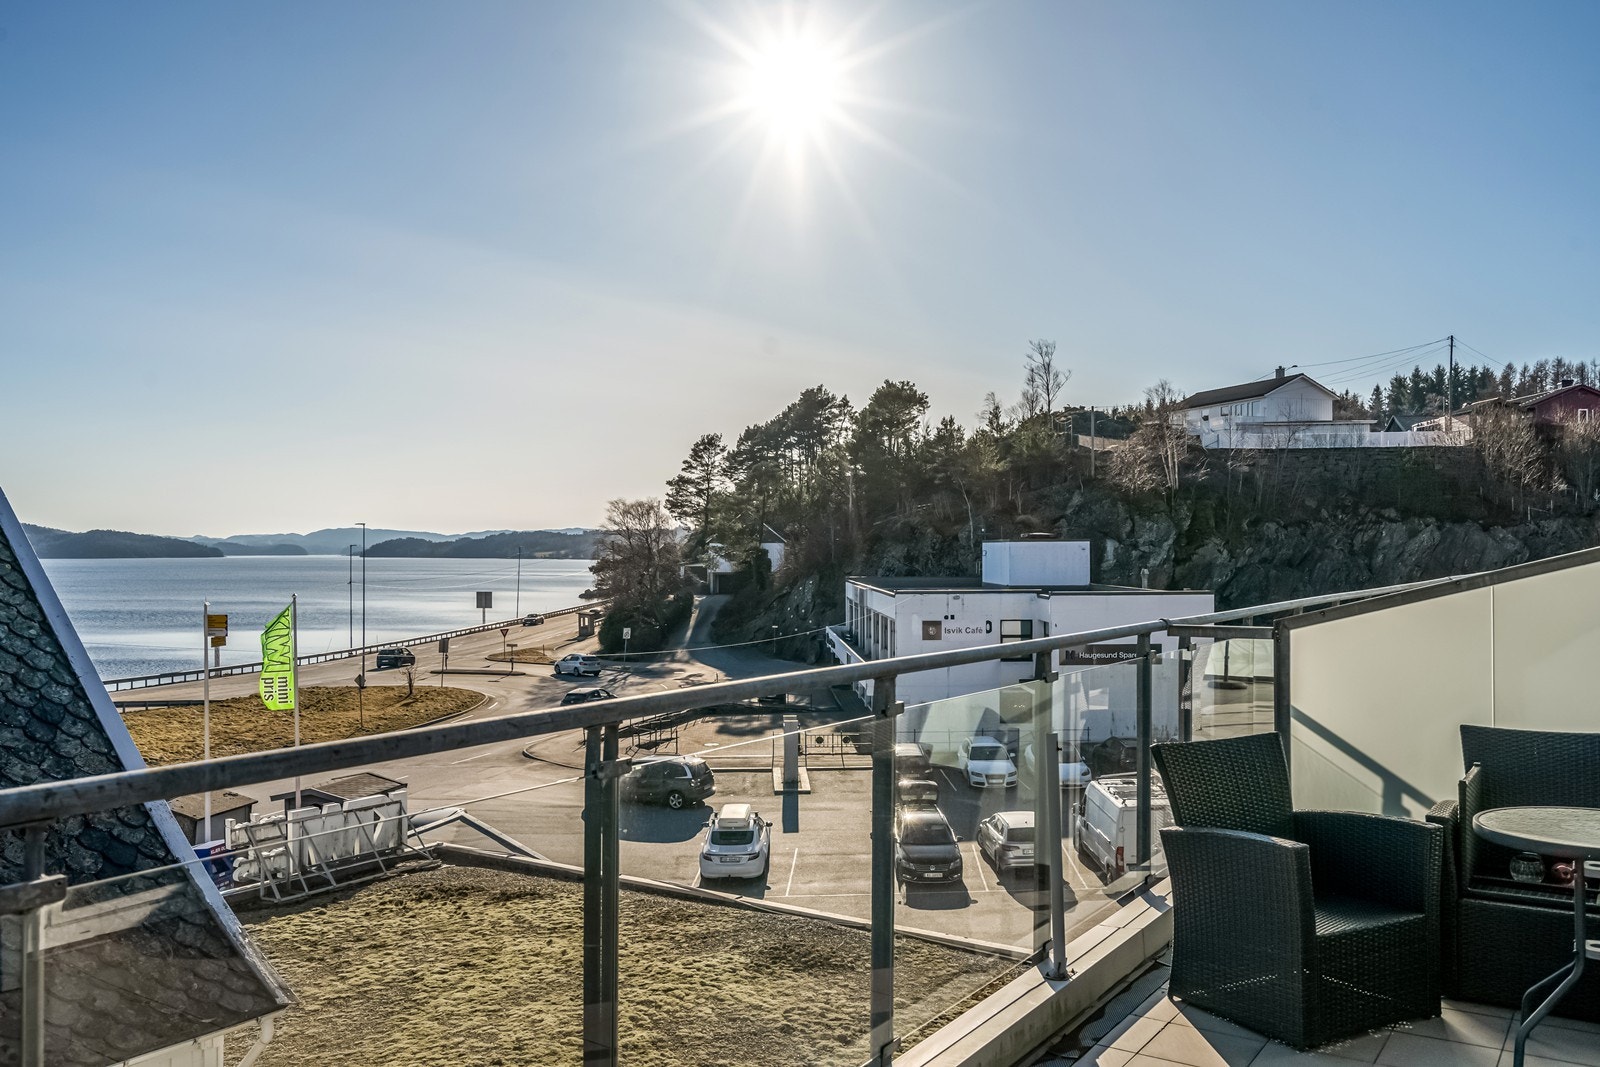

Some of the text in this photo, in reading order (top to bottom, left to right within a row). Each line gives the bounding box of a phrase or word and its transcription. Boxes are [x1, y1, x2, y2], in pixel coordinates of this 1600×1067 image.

[264, 608, 291, 673] KIWI
[944, 626, 983, 634] Isvik Café
[1079, 651, 1118, 660] Haugesund
[261, 677, 277, 701] pris
[277, 676, 292, 704] mini
